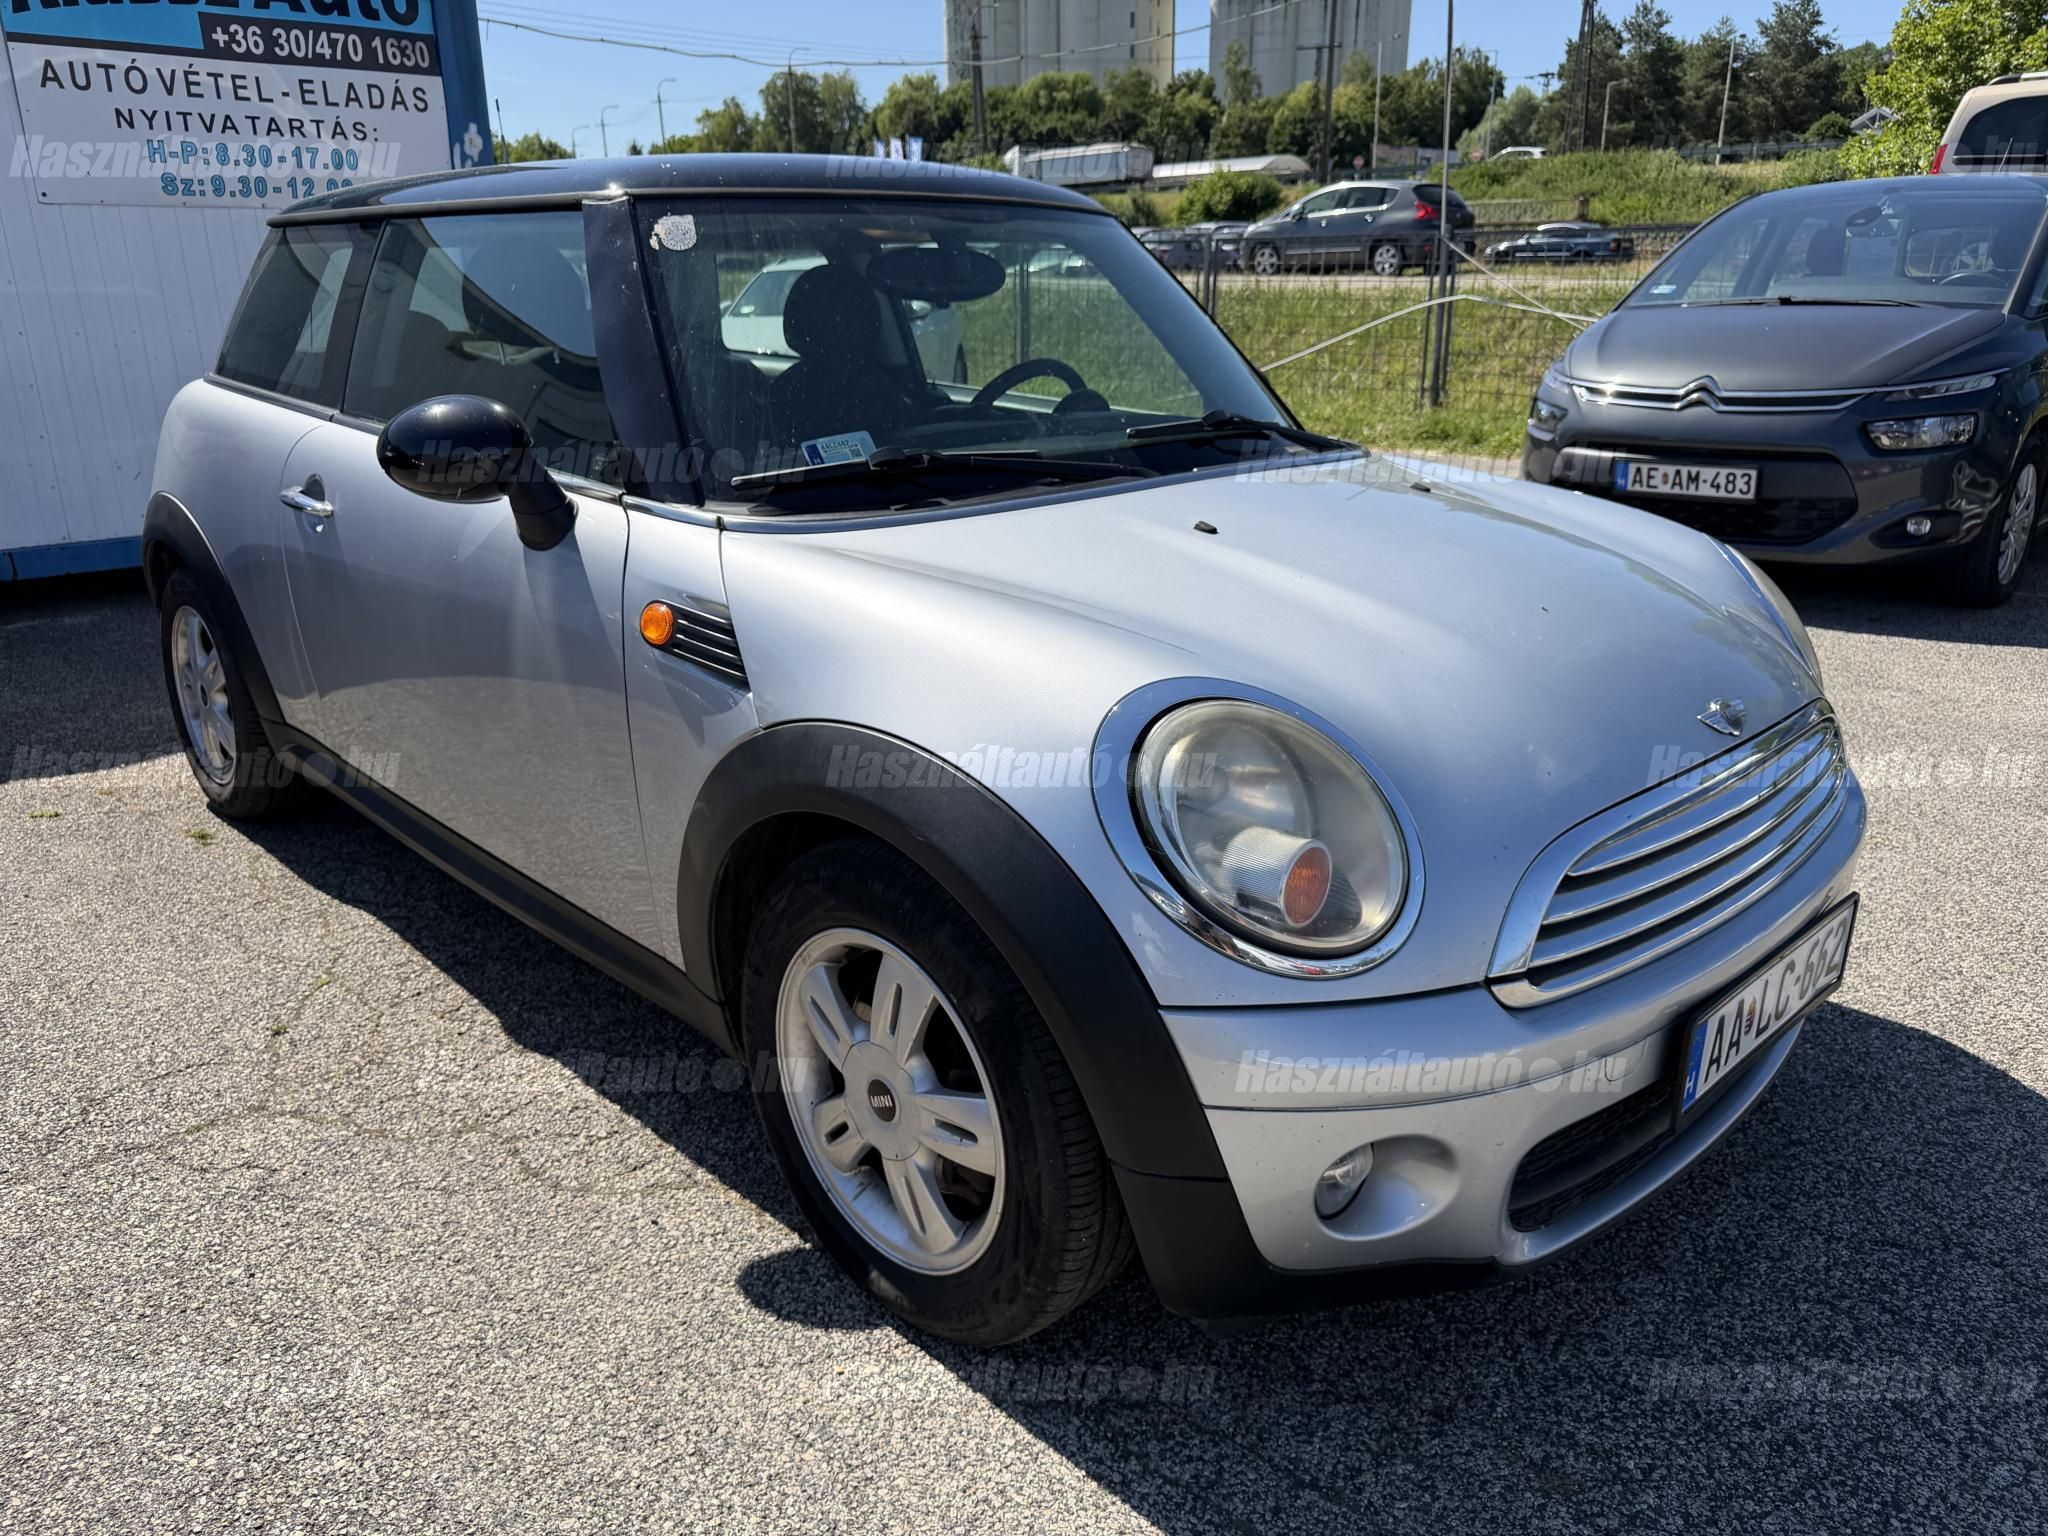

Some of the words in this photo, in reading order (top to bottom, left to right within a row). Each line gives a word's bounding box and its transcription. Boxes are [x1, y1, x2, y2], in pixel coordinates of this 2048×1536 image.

[211, 23, 265, 55] +36
[272, 28, 363, 62] 30/470
[371, 36, 430, 68] 1630
[114, 107, 379, 142] NYITVATARTÁS:
[1631, 466, 1660, 489] AE
[1670, 469, 1752, 495] AM-483
[1704, 998, 1745, 1085] AA
[870, 1095, 893, 1107] MINI
